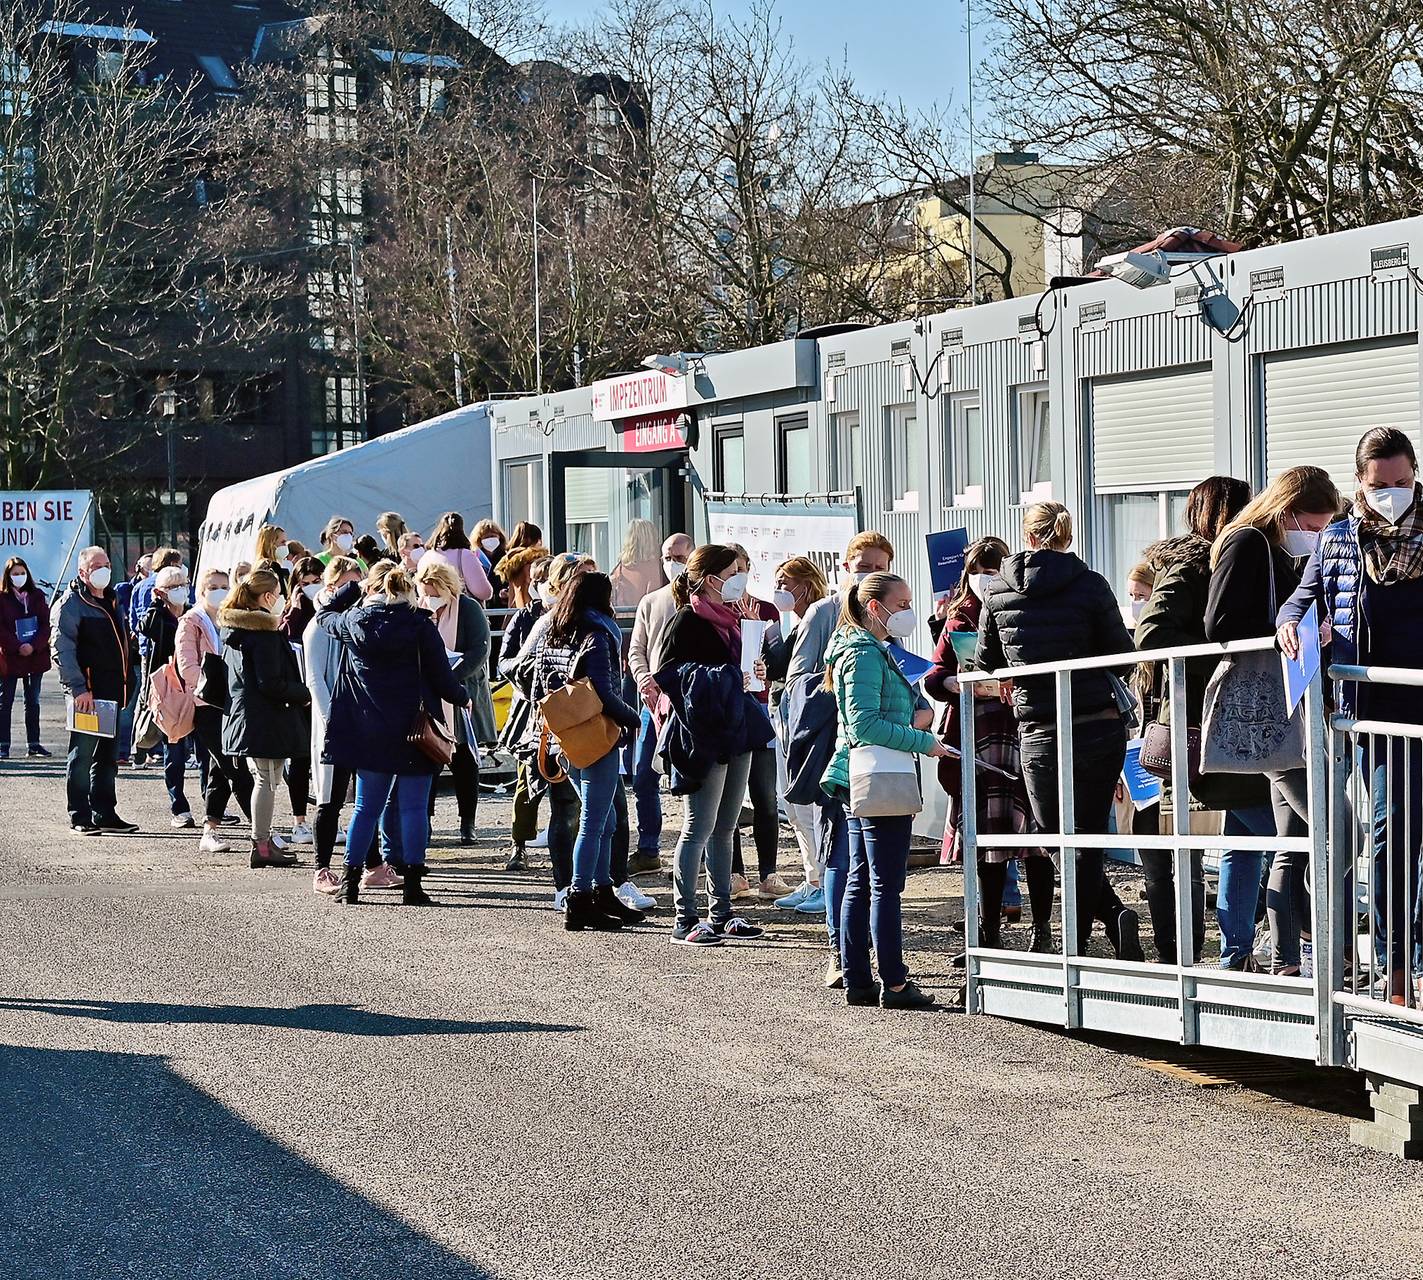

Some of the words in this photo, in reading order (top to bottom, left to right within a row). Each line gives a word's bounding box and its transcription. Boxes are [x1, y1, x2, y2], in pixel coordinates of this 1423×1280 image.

[609, 375, 667, 412] IMPFZENTRUM
[635, 419, 668, 447] EINGANG
[669, 417, 676, 442] A
[2, 500, 37, 521] BEN
[43, 500, 73, 521] SIE
